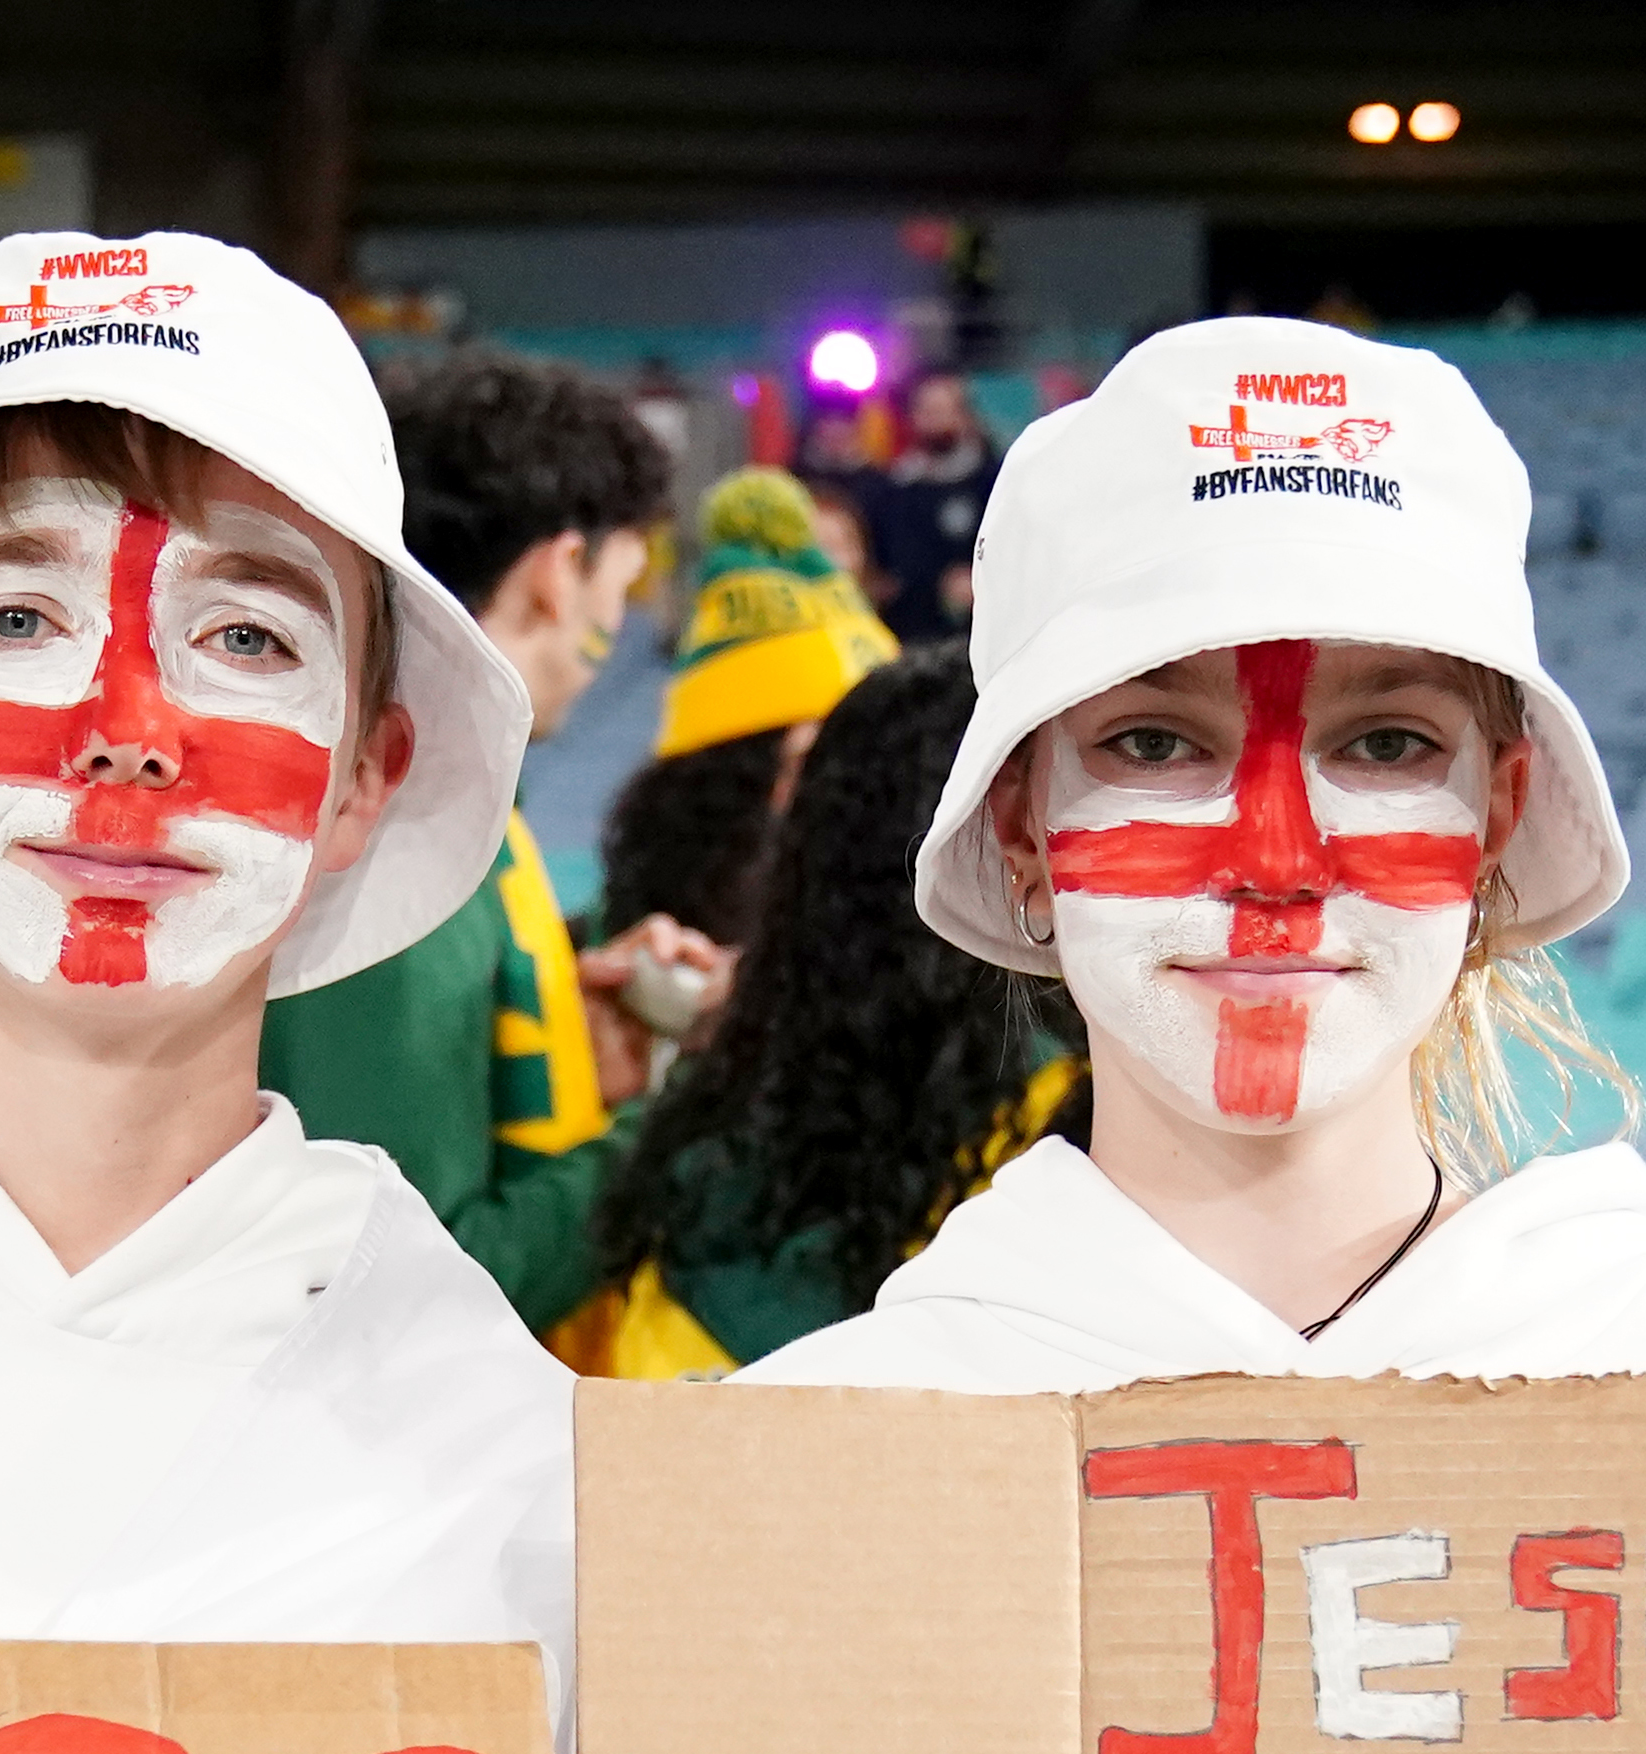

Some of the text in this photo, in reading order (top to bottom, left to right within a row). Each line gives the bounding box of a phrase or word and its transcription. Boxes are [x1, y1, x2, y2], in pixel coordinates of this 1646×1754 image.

[39, 249, 147, 281] #WWC23
[1235, 373, 1347, 407] #WWC23
[1202, 429, 1233, 447] FREE
[1192, 466, 1403, 511] #BYFANSFORFANS
